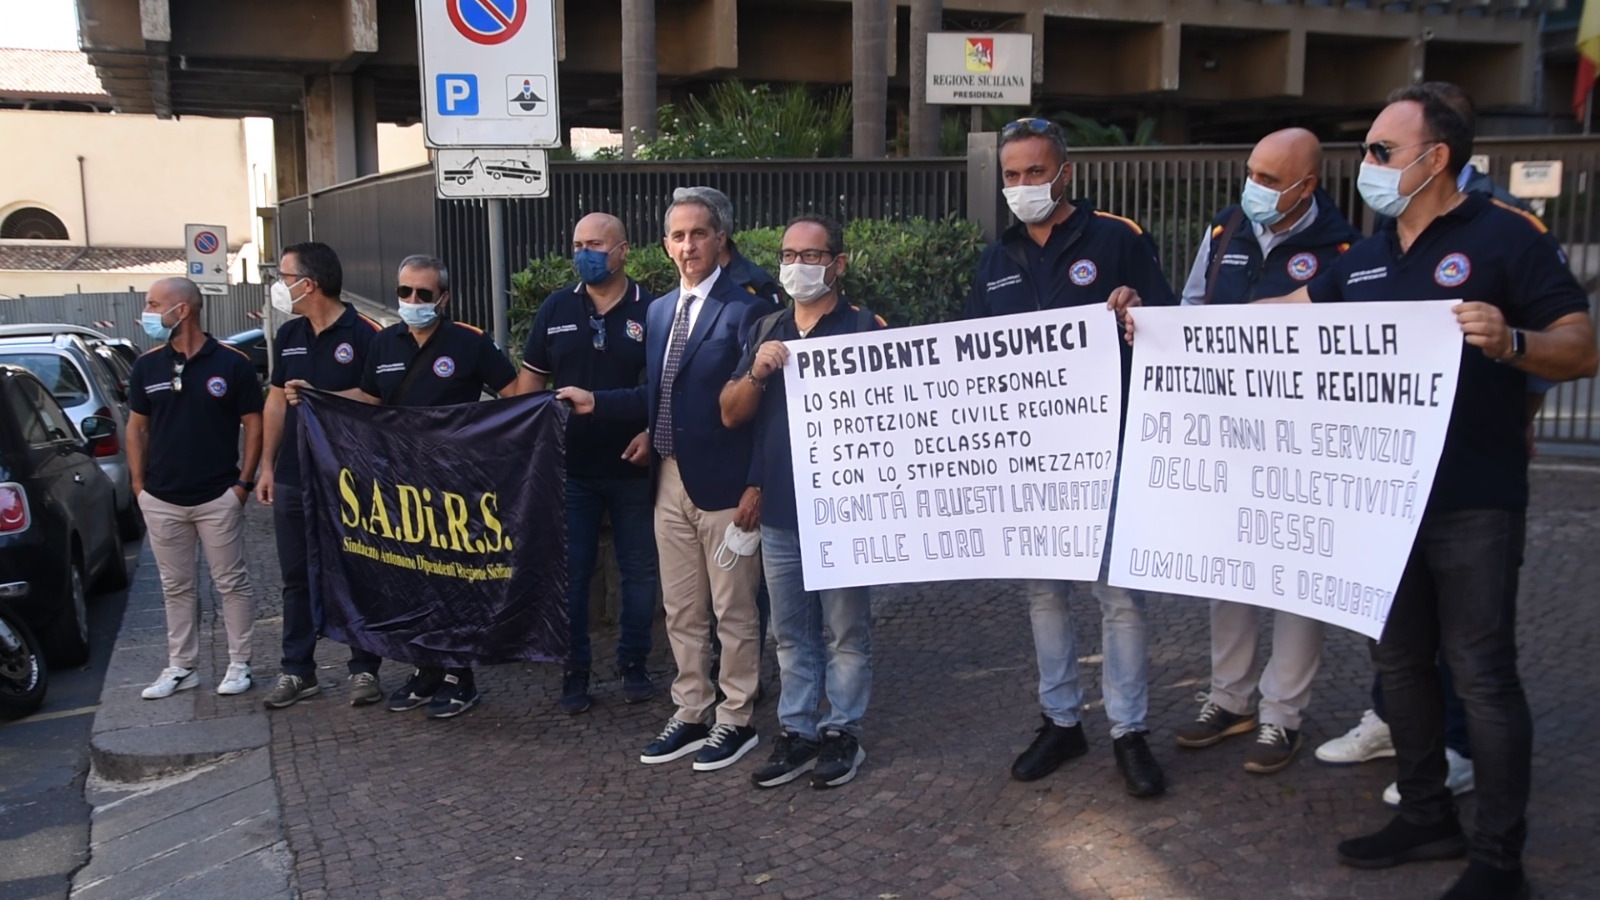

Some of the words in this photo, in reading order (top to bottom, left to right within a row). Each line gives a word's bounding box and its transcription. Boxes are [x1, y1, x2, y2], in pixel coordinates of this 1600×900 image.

[445, 78, 470, 111] P
[933, 74, 975, 87] REGIONE
[977, 74, 1025, 88] SICILIANA
[953, 90, 1004, 99] PRESIDENZA
[796, 337, 941, 379] PRESIDENTE
[954, 320, 1088, 363] MUSUMECI
[1183, 325, 1300, 354] PERSONALE
[1318, 324, 1398, 356] DELLA
[804, 393, 823, 413] LO
[829, 389, 856, 410] SAI
[864, 386, 895, 406] CHE
[904, 383, 919, 402] IL
[923, 379, 959, 399] TUO
[966, 368, 1068, 396] PERSONALE
[1143, 365, 1237, 397] PROTEZIONE
[1245, 368, 1304, 400] CIVILE
[1316, 371, 1444, 408] REGIONALE
[806, 421, 822, 439] DI
[833, 410, 939, 436] PROTEZIONE
[951, 403, 1010, 426] CIVILE
[1018, 394, 1109, 420] REGIONALE
[1141, 411, 1172, 444] DA
[1183, 413, 1211, 447] 20
[1219, 415, 1266, 452] ANNI
[1275, 419, 1302, 455] AL
[1310, 422, 1416, 466] SERVIZIO
[833, 441, 895, 462] STATO
[914, 430, 1032, 456] DECLASSATO
[812, 471, 822, 489] E
[832, 468, 865, 486] CON
[878, 466, 897, 483] LO
[907, 458, 998, 481] STIPENDIO
[1008, 450, 1112, 474] DIMEZZATO?
[1148, 455, 1229, 493] DELLA
[338, 467, 514, 554] S.A.Di.R.S.
[1237, 506, 1335, 558] ADESSO
[342, 535, 380, 561] Sindacato
[380, 547, 417, 570] Autonomo
[415, 553, 457, 578] Dipendenti
[455, 561, 487, 584] Regione
[819, 541, 836, 568] E
[852, 533, 910, 565] ALLE
[923, 528, 986, 560] LORO
[1002, 524, 1102, 558] FAMIGLIE
[1129, 548, 1256, 591] UMILIATO
[1271, 564, 1285, 596] E
